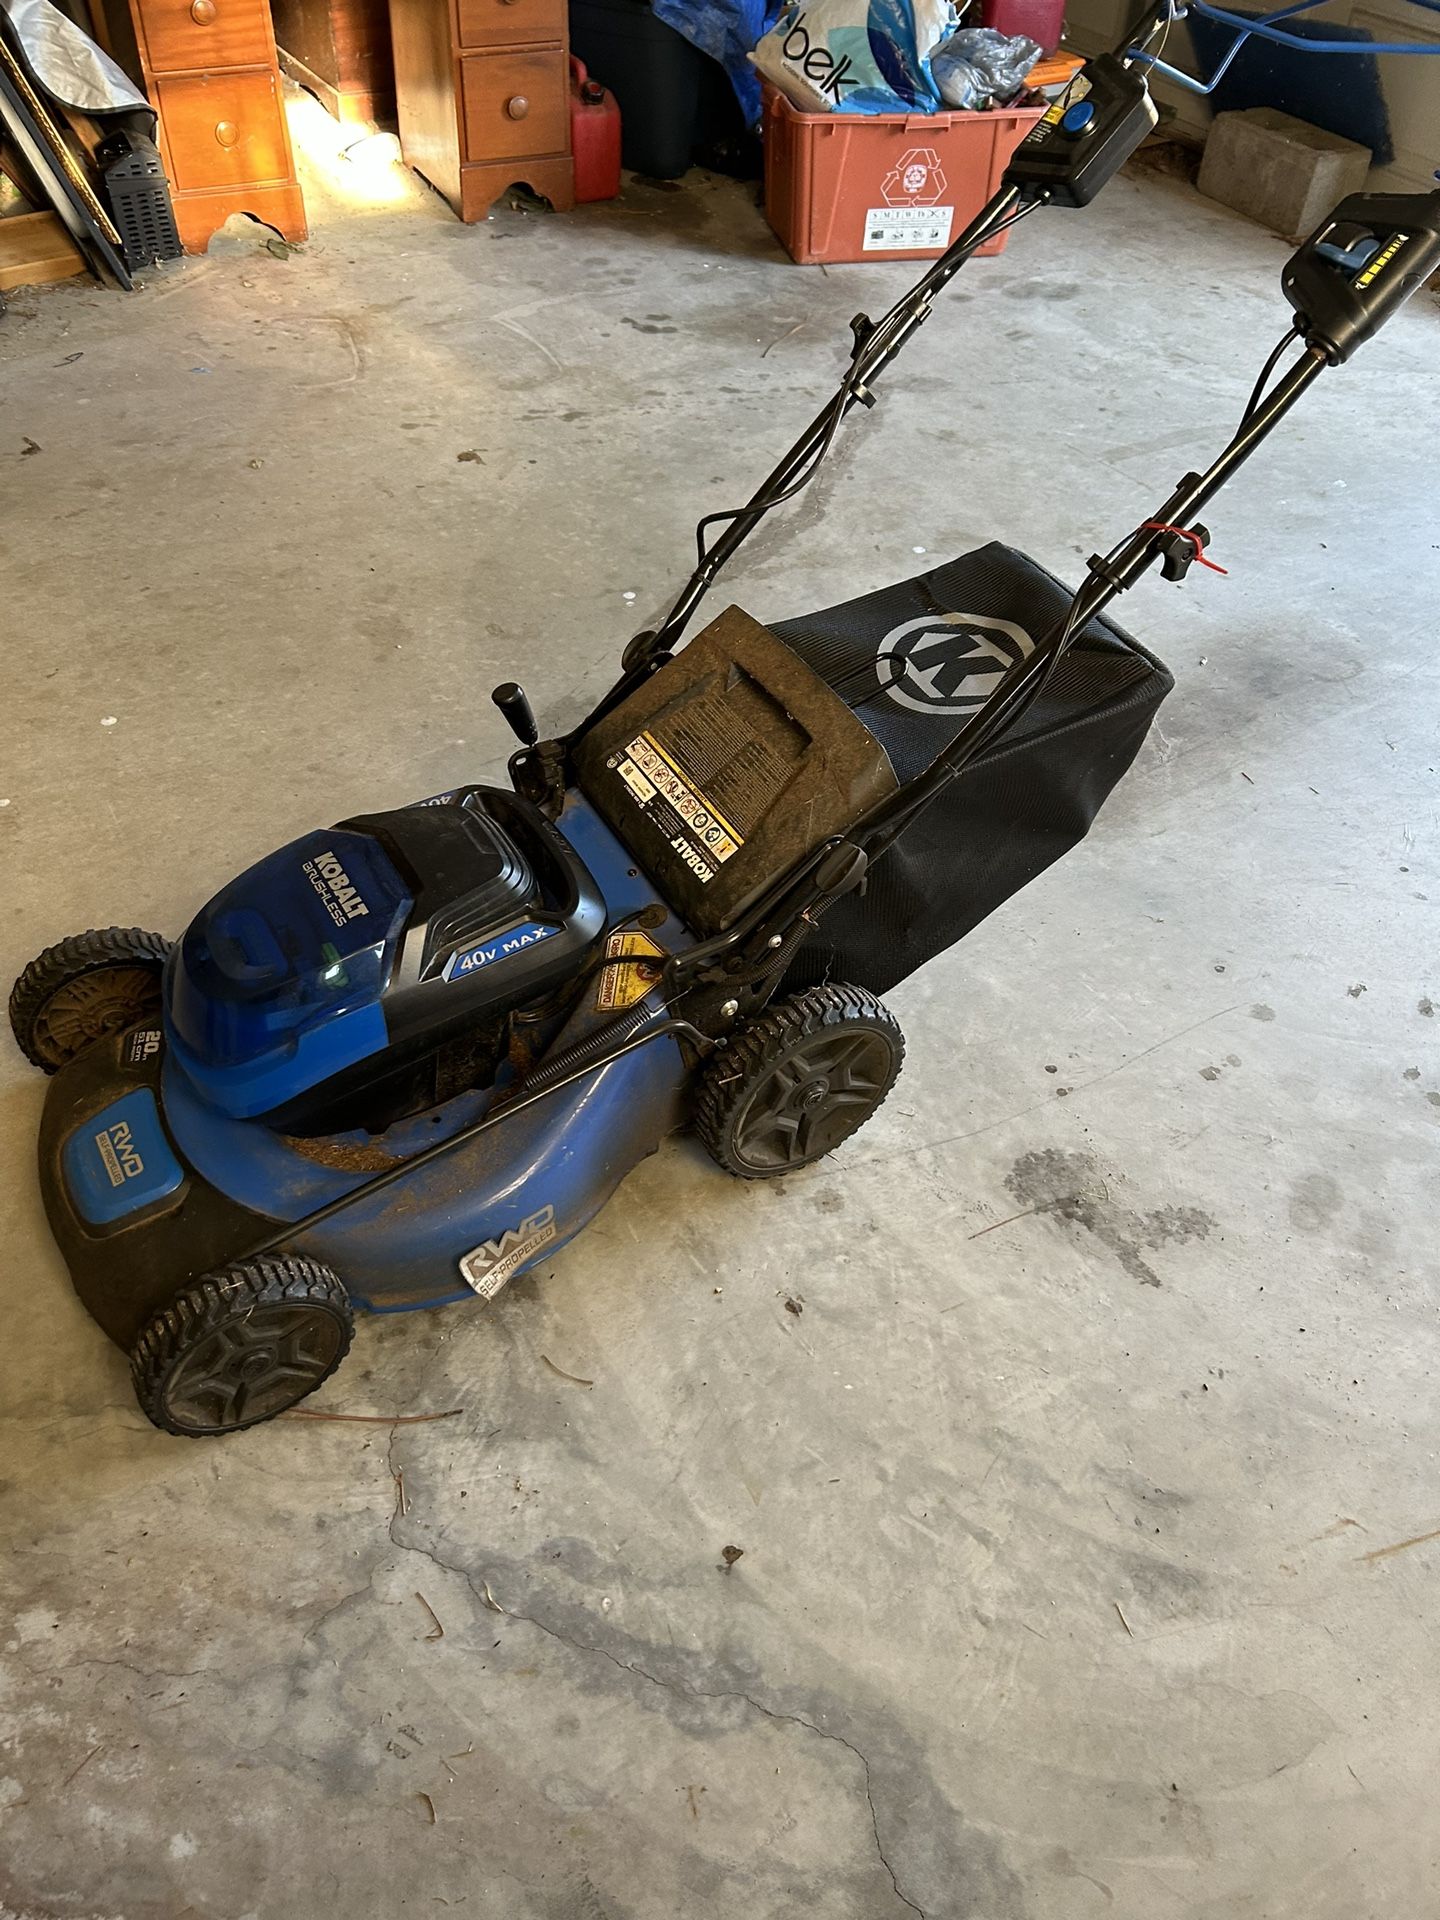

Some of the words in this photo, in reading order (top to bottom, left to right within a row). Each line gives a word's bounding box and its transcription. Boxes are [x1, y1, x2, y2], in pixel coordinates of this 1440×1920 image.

[783, 12, 860, 106] belk
[313, 851, 369, 919] KOBALT
[670, 838, 714, 883] KOBALT
[302, 861, 347, 928] BRUSHLESS
[502, 927, 548, 952] MAX
[138, 1031, 145, 1044] 51
[144, 1031, 161, 1053] 20
[98, 1132, 123, 1185] SELF-PROPELLED
[109, 1121, 144, 1177] RWD
[459, 1204, 553, 1280] RWD
[480, 1227, 553, 1296] SELF-PROPELLED
